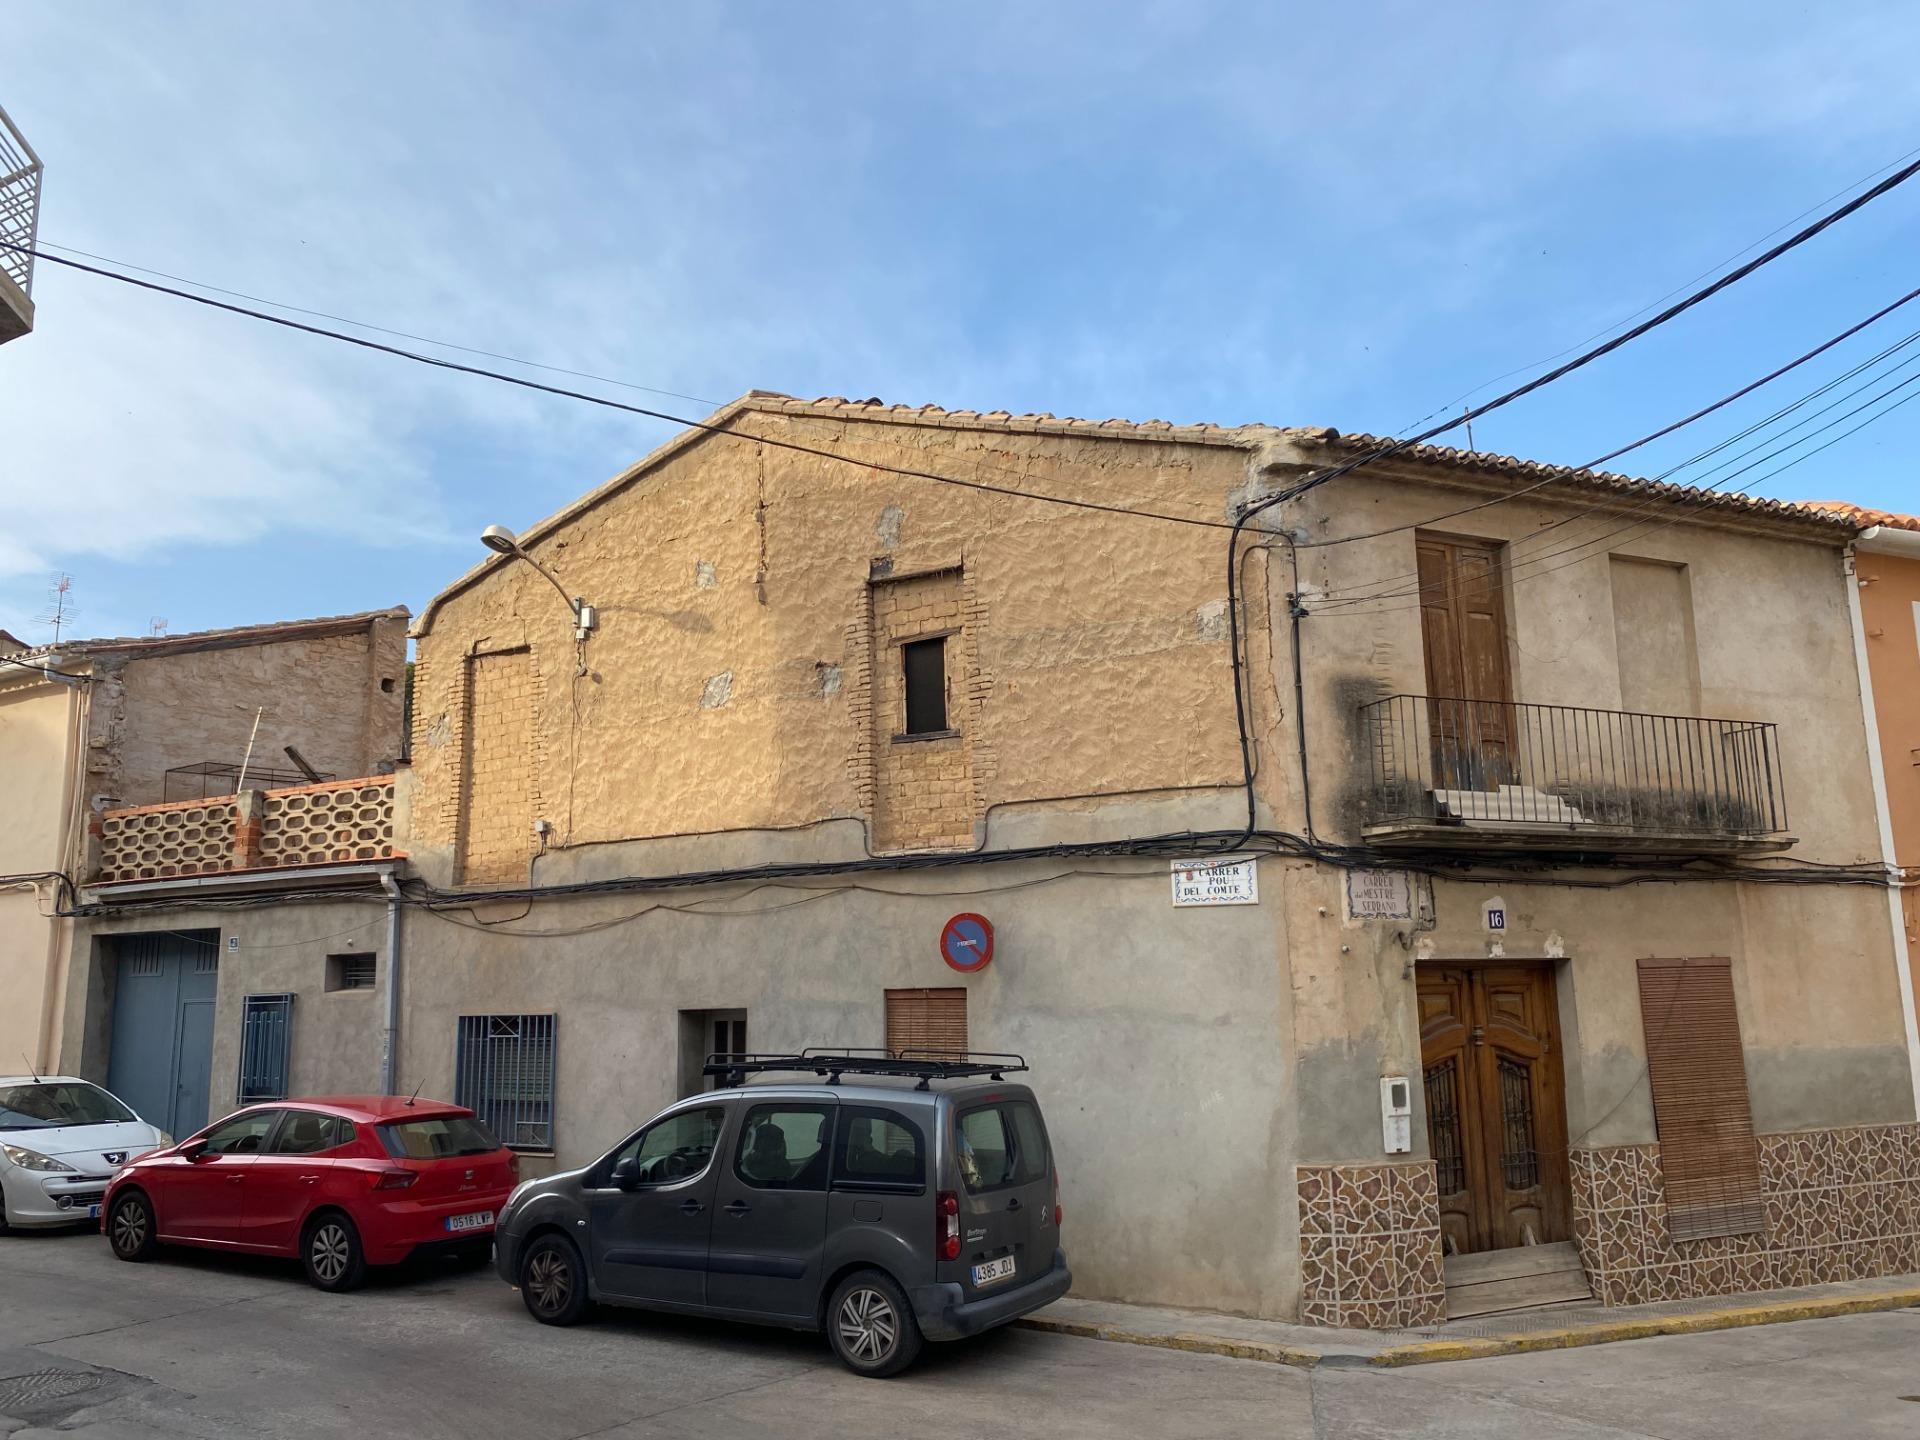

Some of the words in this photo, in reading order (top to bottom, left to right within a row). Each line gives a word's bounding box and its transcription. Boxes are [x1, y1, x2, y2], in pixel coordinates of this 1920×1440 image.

[1199, 867, 1239, 877] CARRER
[1209, 876, 1229, 886] POU
[1363, 876, 1394, 888] CARRER
[1184, 887, 1201, 896] DEL
[1207, 885, 1240, 895] COMTE
[1364, 888, 1396, 900] MESTRE
[1362, 900, 1397, 912] SERRANO
[1491, 912, 1502, 927] 16
[453, 1215, 474, 1229] 0516
[977, 1263, 996, 1280] 4385
